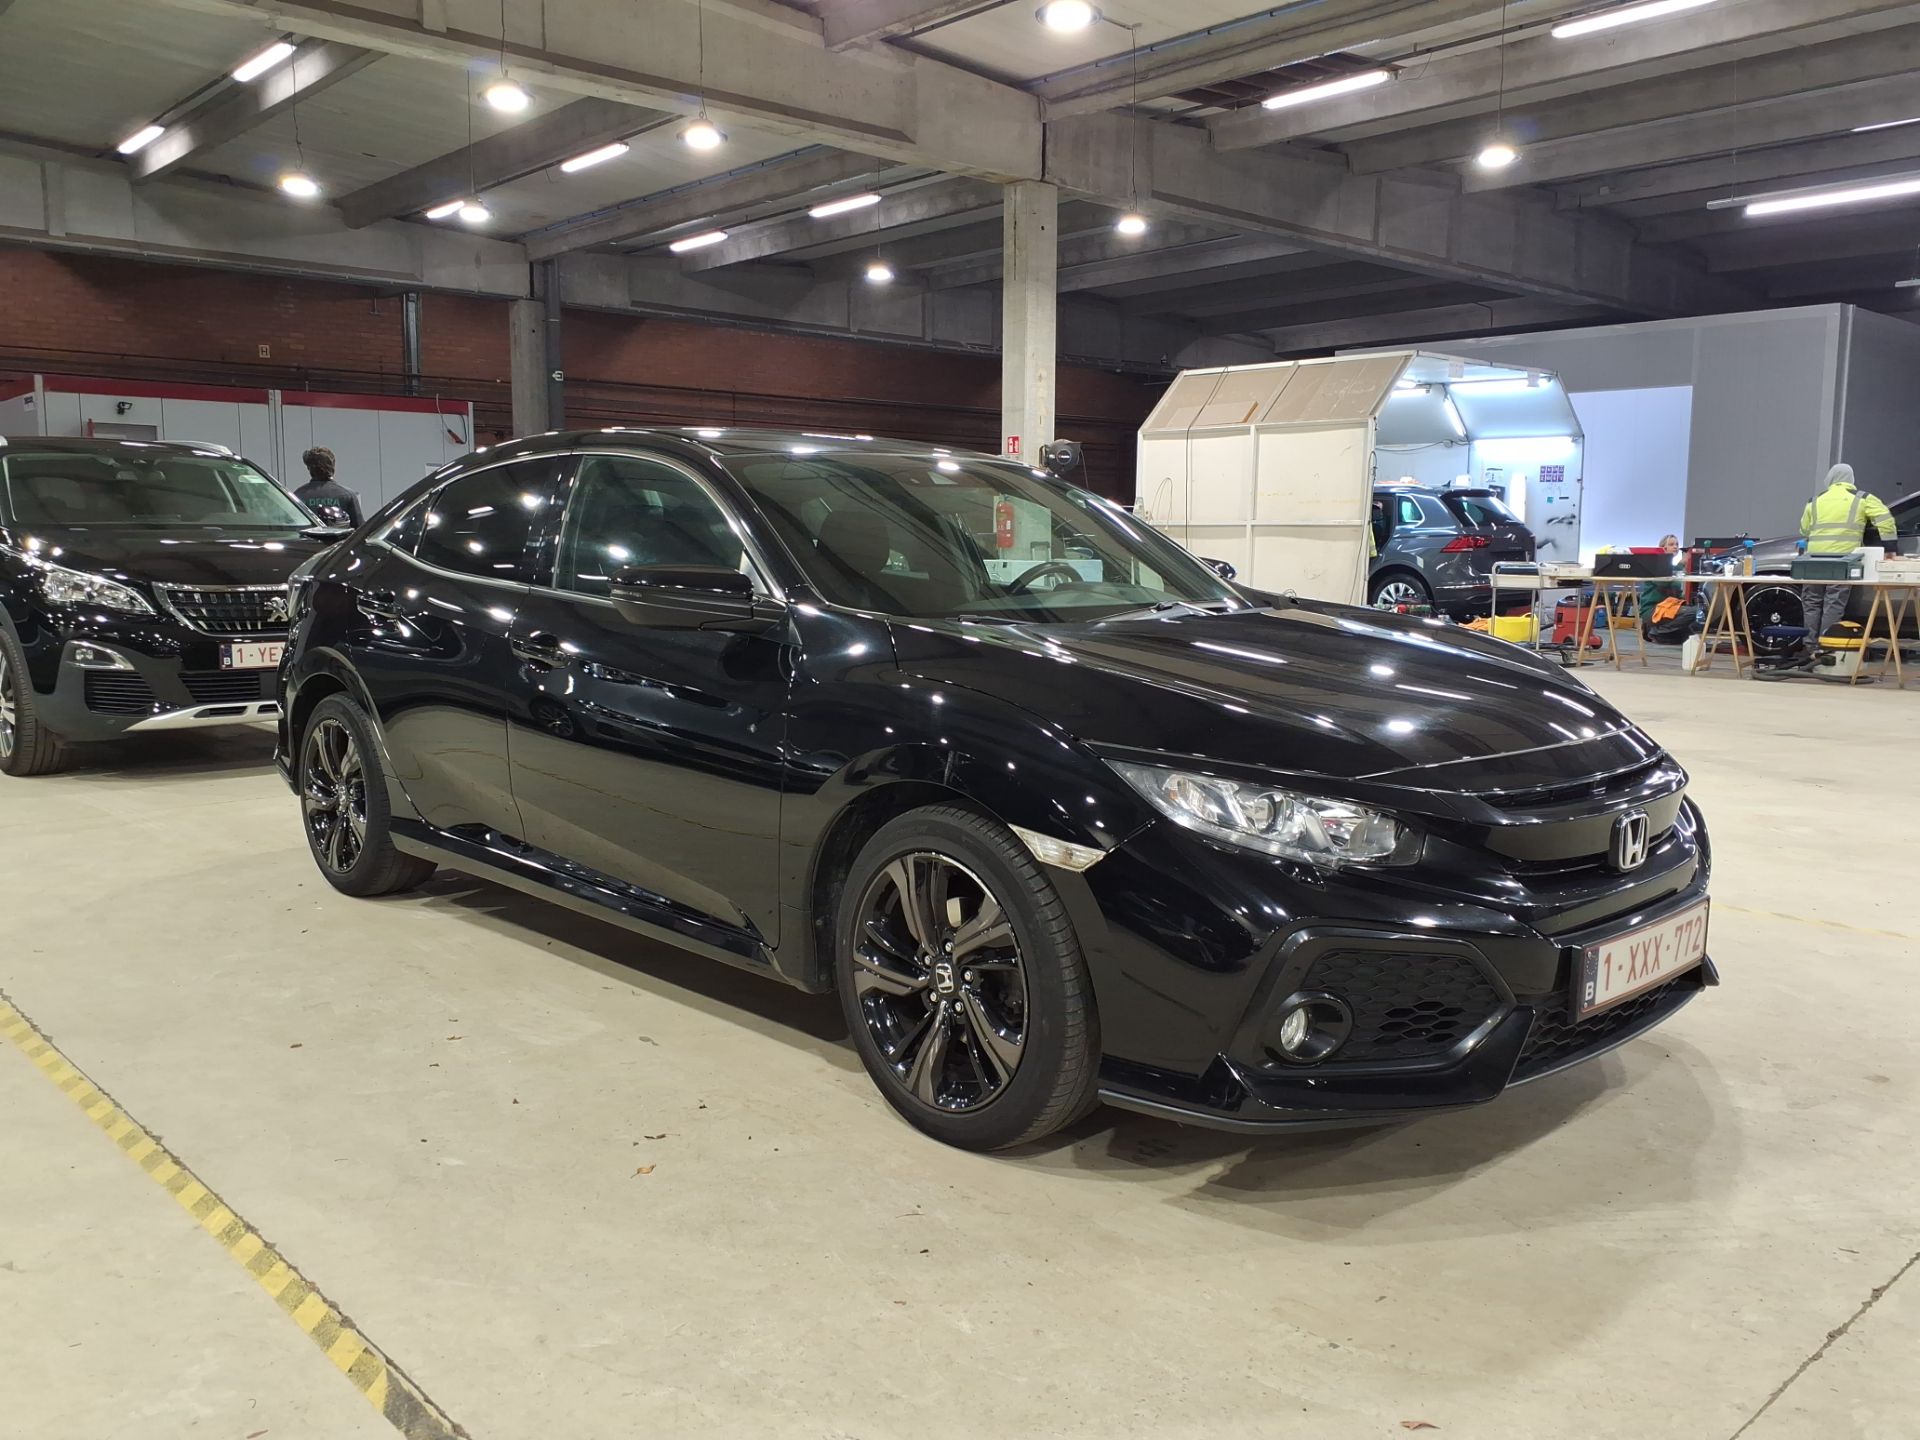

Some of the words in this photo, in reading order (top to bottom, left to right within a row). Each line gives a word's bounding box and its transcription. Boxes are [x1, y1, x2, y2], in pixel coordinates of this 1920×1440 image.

[236, 646, 286, 664] 1-YE
[1603, 915, 1703, 992] 1-XXX-772
[1584, 980, 1595, 1001] B
